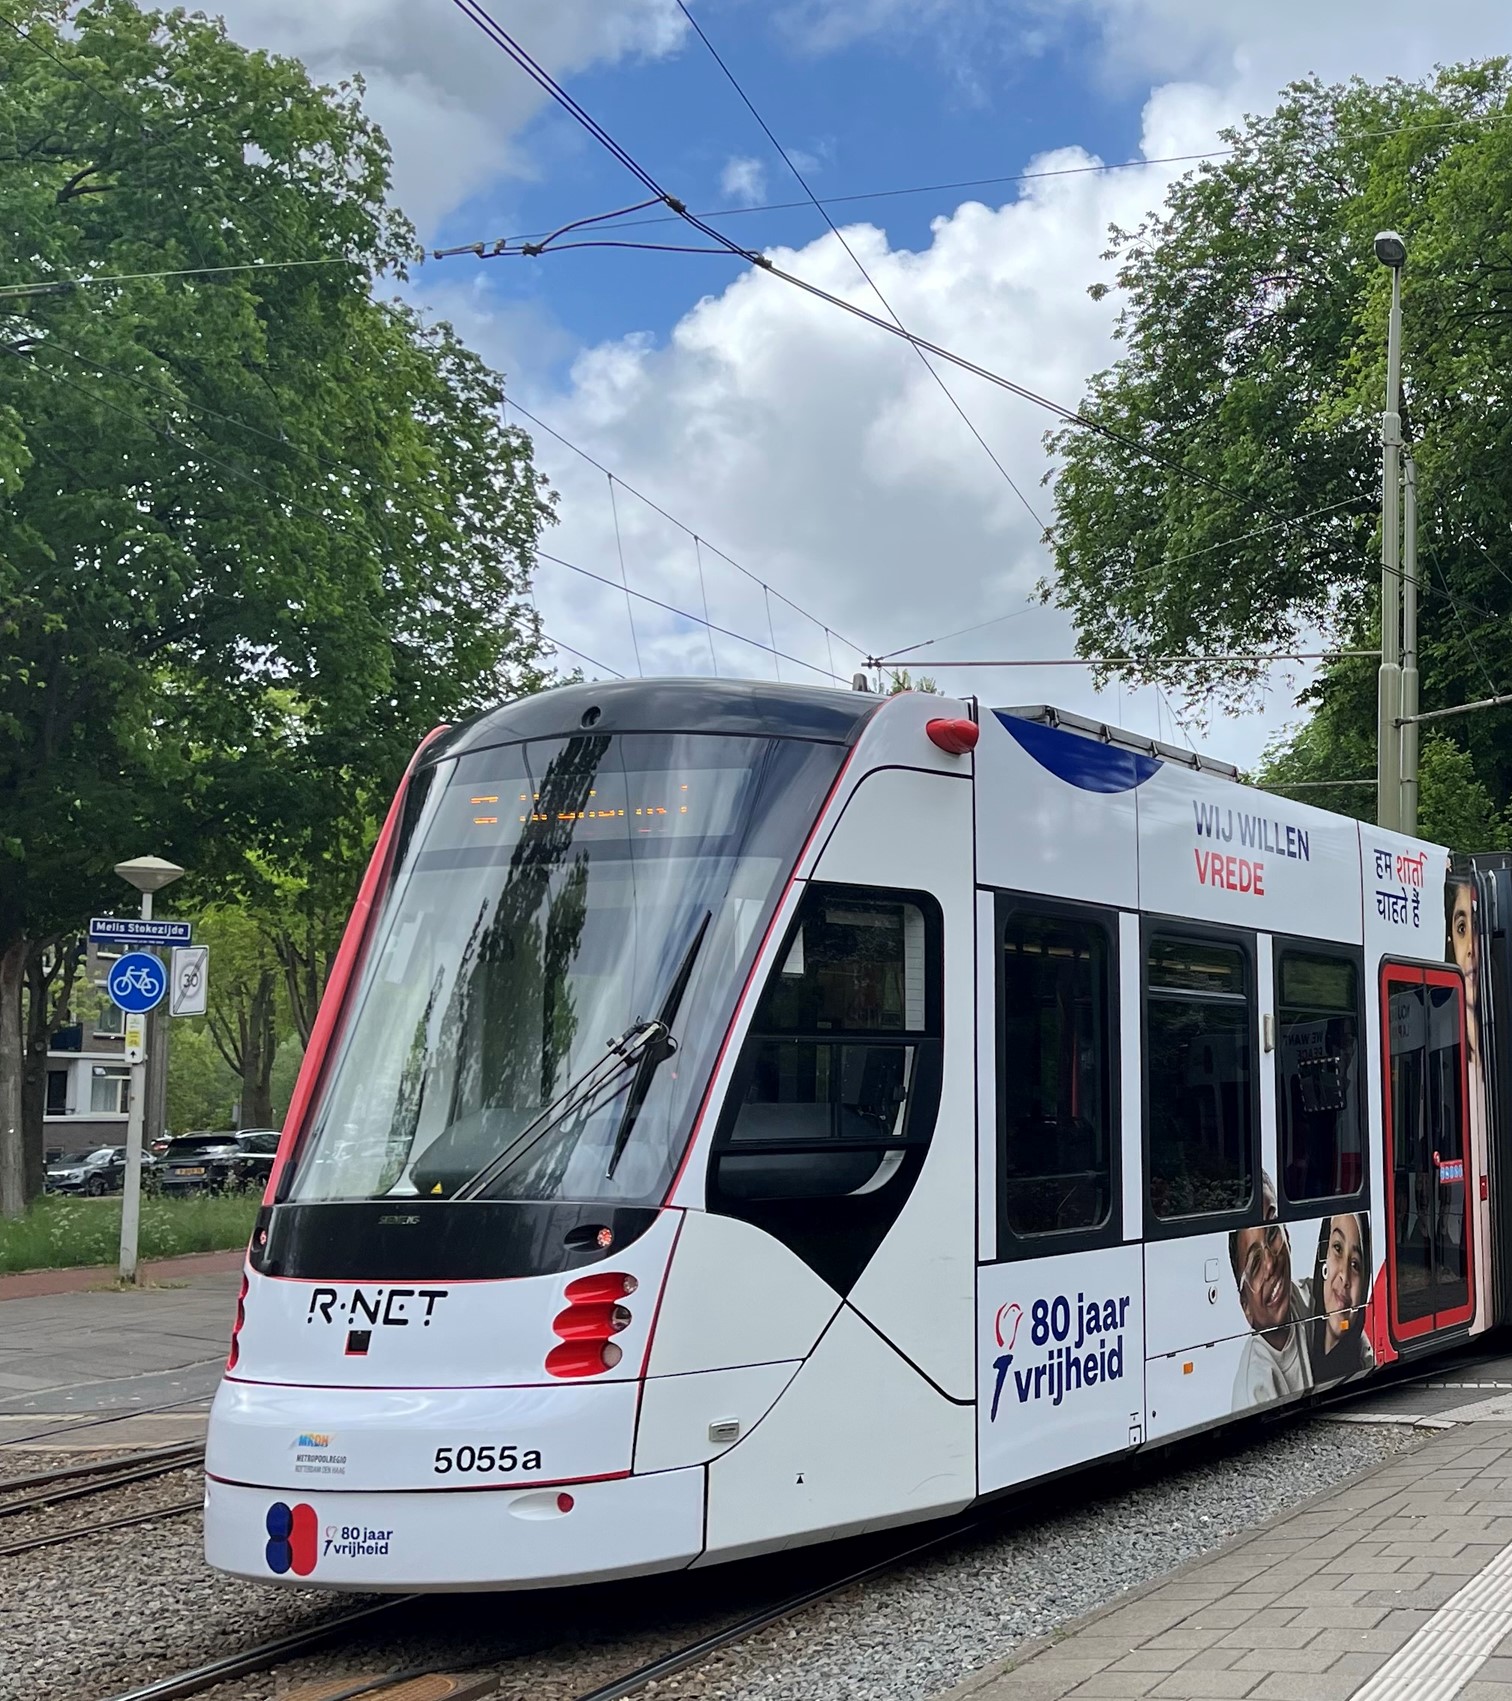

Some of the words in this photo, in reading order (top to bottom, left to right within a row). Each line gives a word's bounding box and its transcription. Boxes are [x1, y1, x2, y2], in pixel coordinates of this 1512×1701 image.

[1193, 800, 1233, 842] WIJ
[1238, 812, 1310, 861] WILLEN
[1194, 848, 1265, 896] VREDE
[1374, 848, 1393, 880] हम
[1376, 886, 1408, 925] चाहते
[96, 921, 126, 932] Melis
[127, 923, 185, 938] Stokezijde
[183, 973, 199, 988] 30
[1031, 1295, 1071, 1346] 80
[1075, 1292, 1130, 1349] jaar
[1014, 1334, 1123, 1406] vrijheid
[434, 1446, 542, 1474] 5055a
[333, 1541, 389, 1558] vrijheid
[341, 1526, 360, 1540] 80
[362, 1527, 394, 1543] jaar
